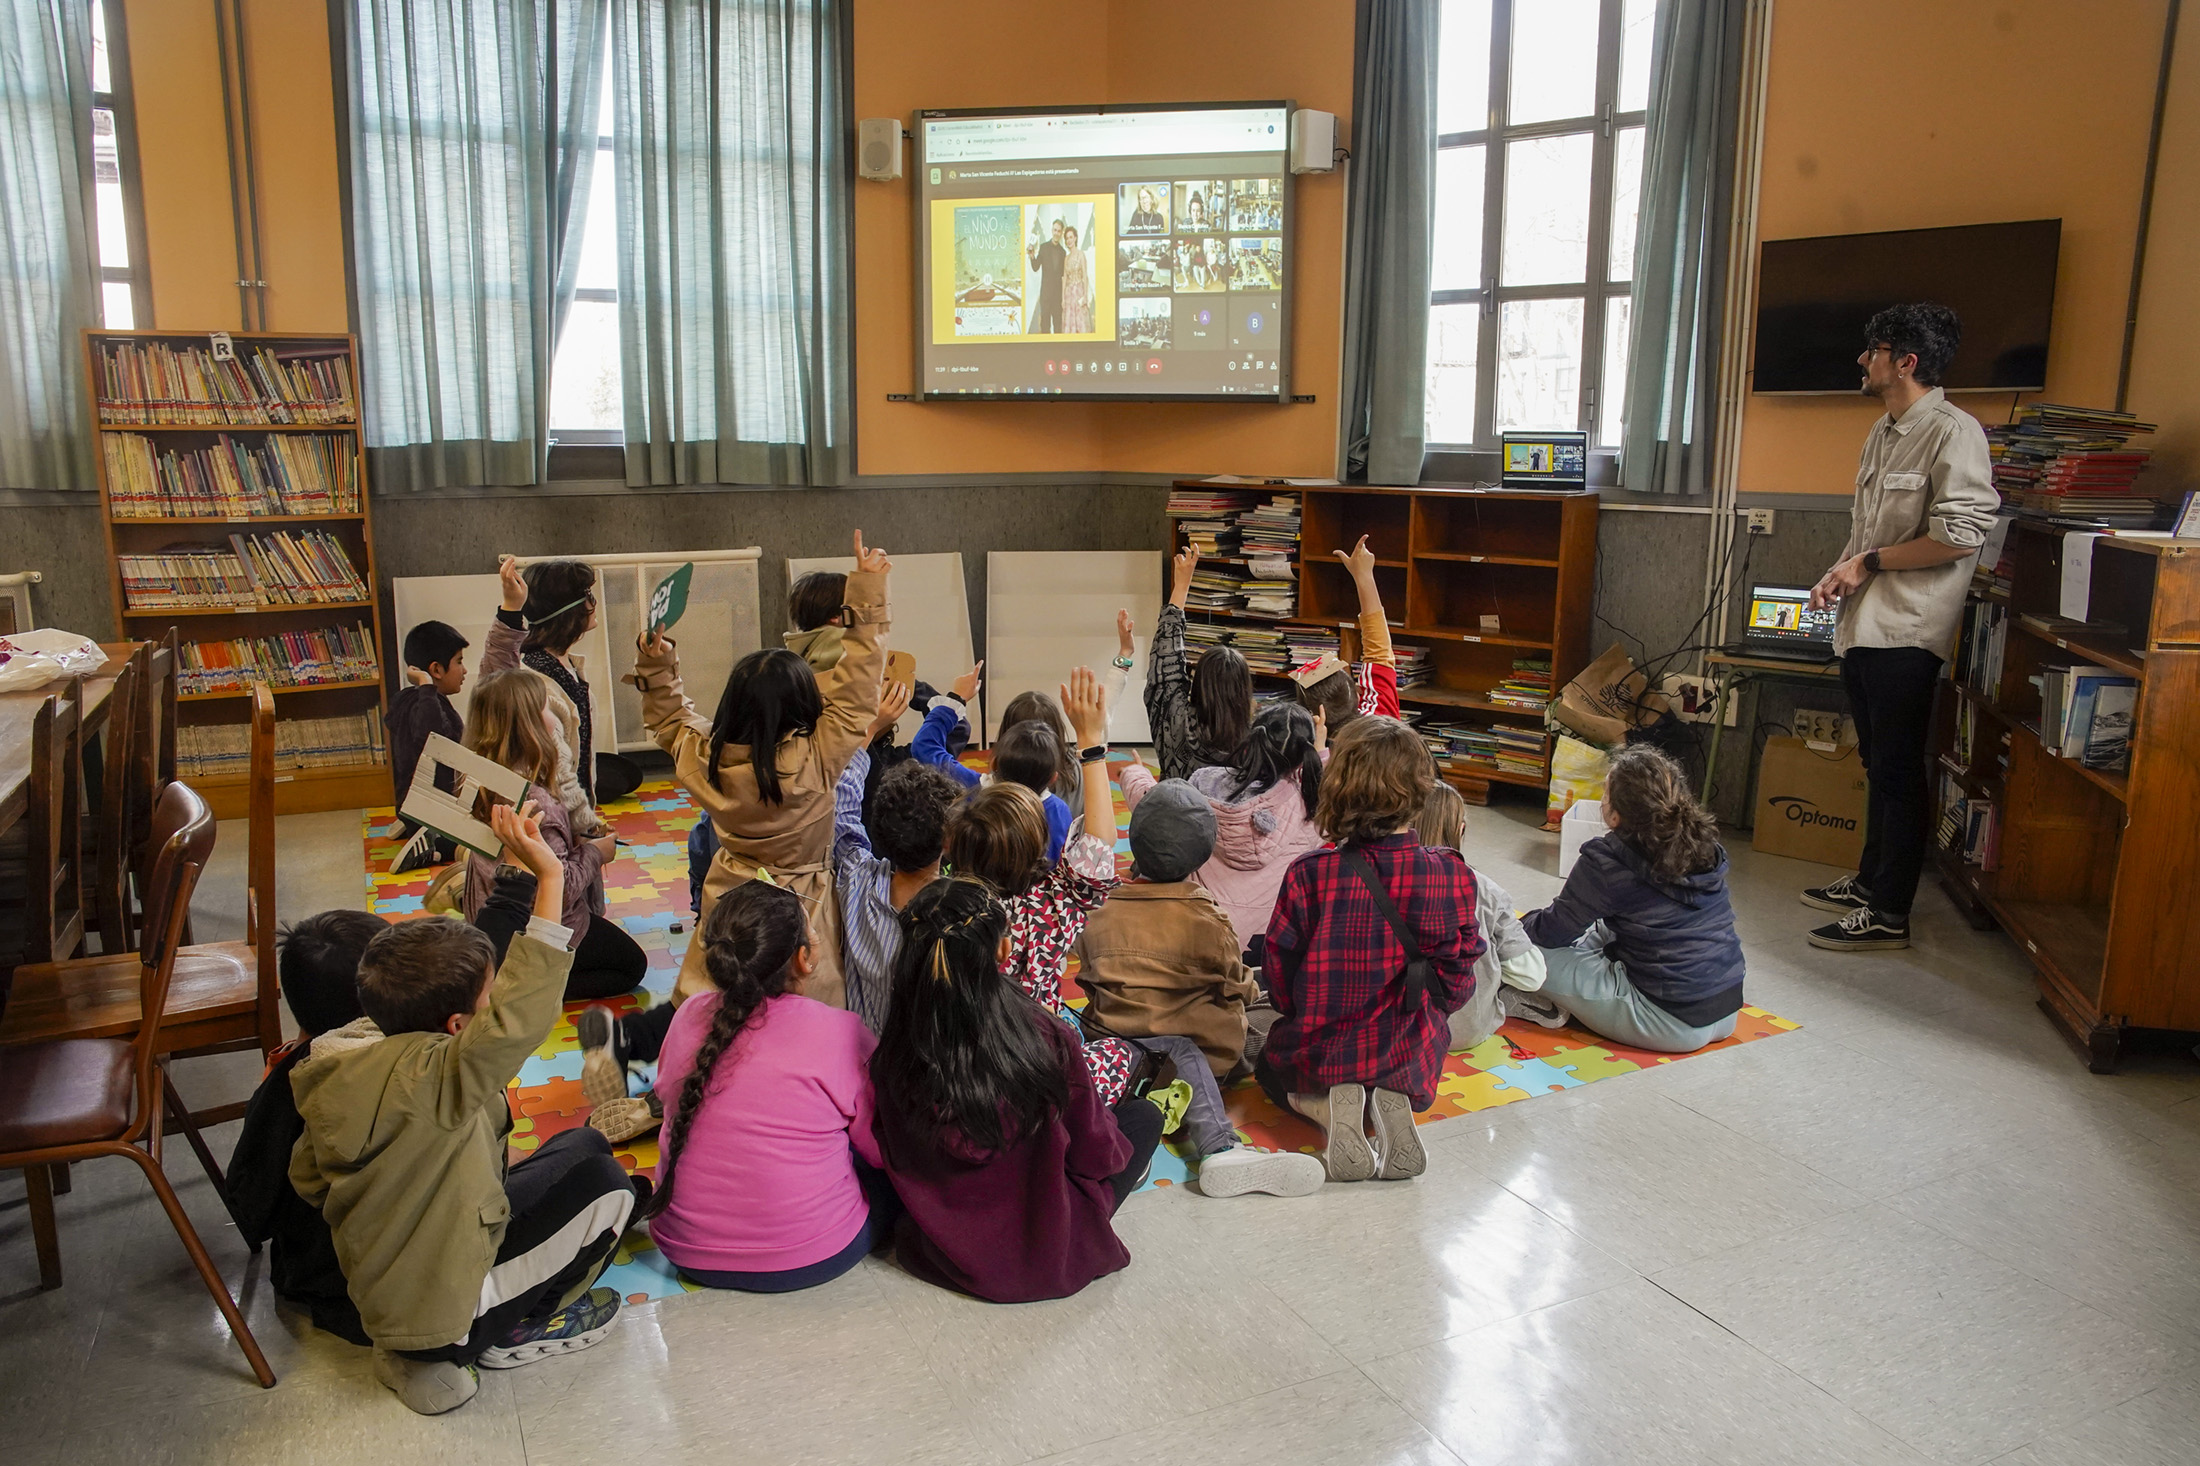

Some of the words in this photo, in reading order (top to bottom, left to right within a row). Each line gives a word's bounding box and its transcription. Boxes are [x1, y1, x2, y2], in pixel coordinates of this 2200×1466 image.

[969, 234, 1007, 250] MUNDO
[1202, 314, 1208, 322] A
[1252, 318, 1258, 328] B
[216, 343, 229, 355] R
[1786, 804, 1857, 831] Optoma
